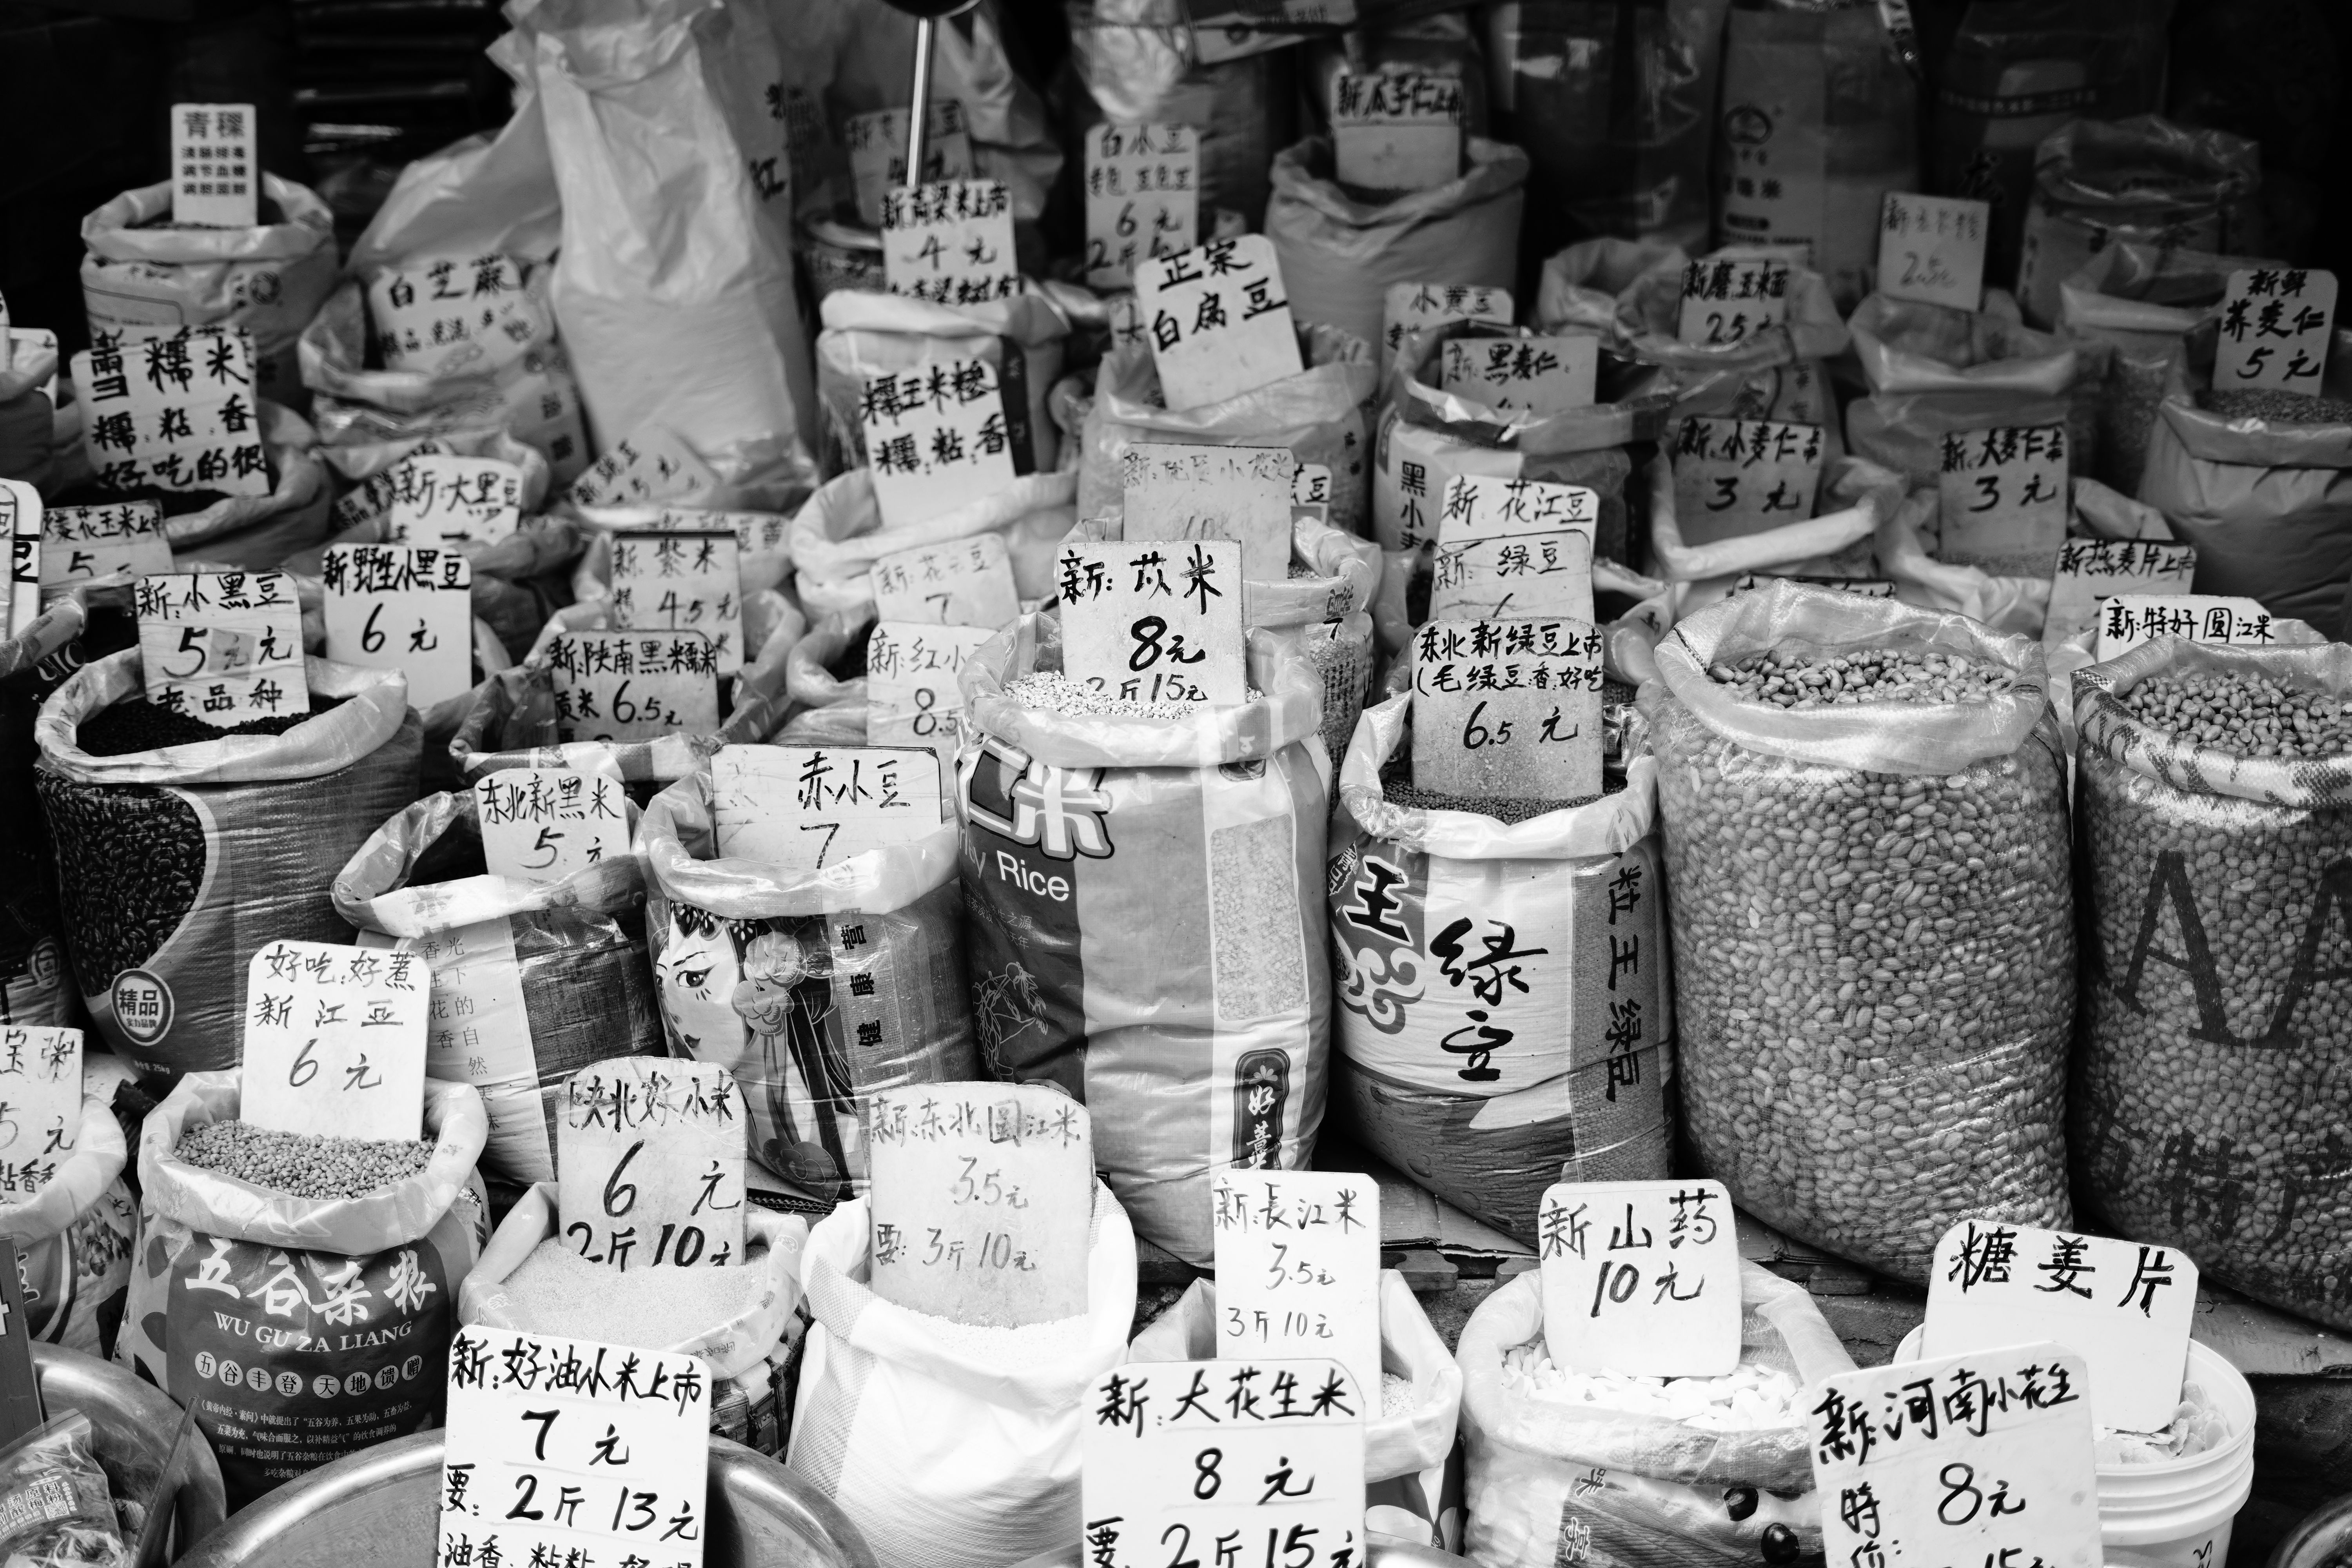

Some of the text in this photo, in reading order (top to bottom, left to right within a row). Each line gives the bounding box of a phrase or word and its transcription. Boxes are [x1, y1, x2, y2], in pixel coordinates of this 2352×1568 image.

[1158, 237, 1253, 292] 正宗
[2247, 269, 2308, 298] 新鲜
[1152, 277, 1289, 352] 白扁豆
[2223, 298, 2325, 343] 荞麦仁
[2237, 347, 2321, 382] 5元
[1706, 477, 1801, 514] 3元
[1968, 474, 2056, 512] 3元
[362, 602, 437, 654] 6元
[1129, 615, 1207, 672] 8元
[1419, 621, 1603, 663] 东北新绿豆上市
[1463, 701, 1579, 750] 6.5元
[478, 772, 624, 825] 东北新黑米
[798, 751, 911, 811] 赤小豆
[800, 822, 841, 870] 7
[996, 849, 1070, 902] Rice
[119, 987, 159, 1016] 精品
[253, 993, 404, 1029] 新江豆
[289, 1038, 383, 1092] 6元
[603, 1138, 742, 1218] 6元
[953, 1154, 1030, 1209] 3.5元
[1539, 1187, 1719, 1261] 新山药
[184, 1236, 437, 1326] 五谷杂粮
[1265, 1241, 1337, 1291] 3.5元
[1590, 1259, 1705, 1318] 10元
[1947, 1221, 2175, 1319] 糖姜片
[213, 1310, 413, 1354] WU GU ZA LIANG
[199, 1354, 421, 1397] 五谷丰登 天地馈赠
[520, 1409, 630, 1466] 7元
[1193, 1446, 1315, 1506] 8元
[1936, 1462, 2027, 1527] 8元
